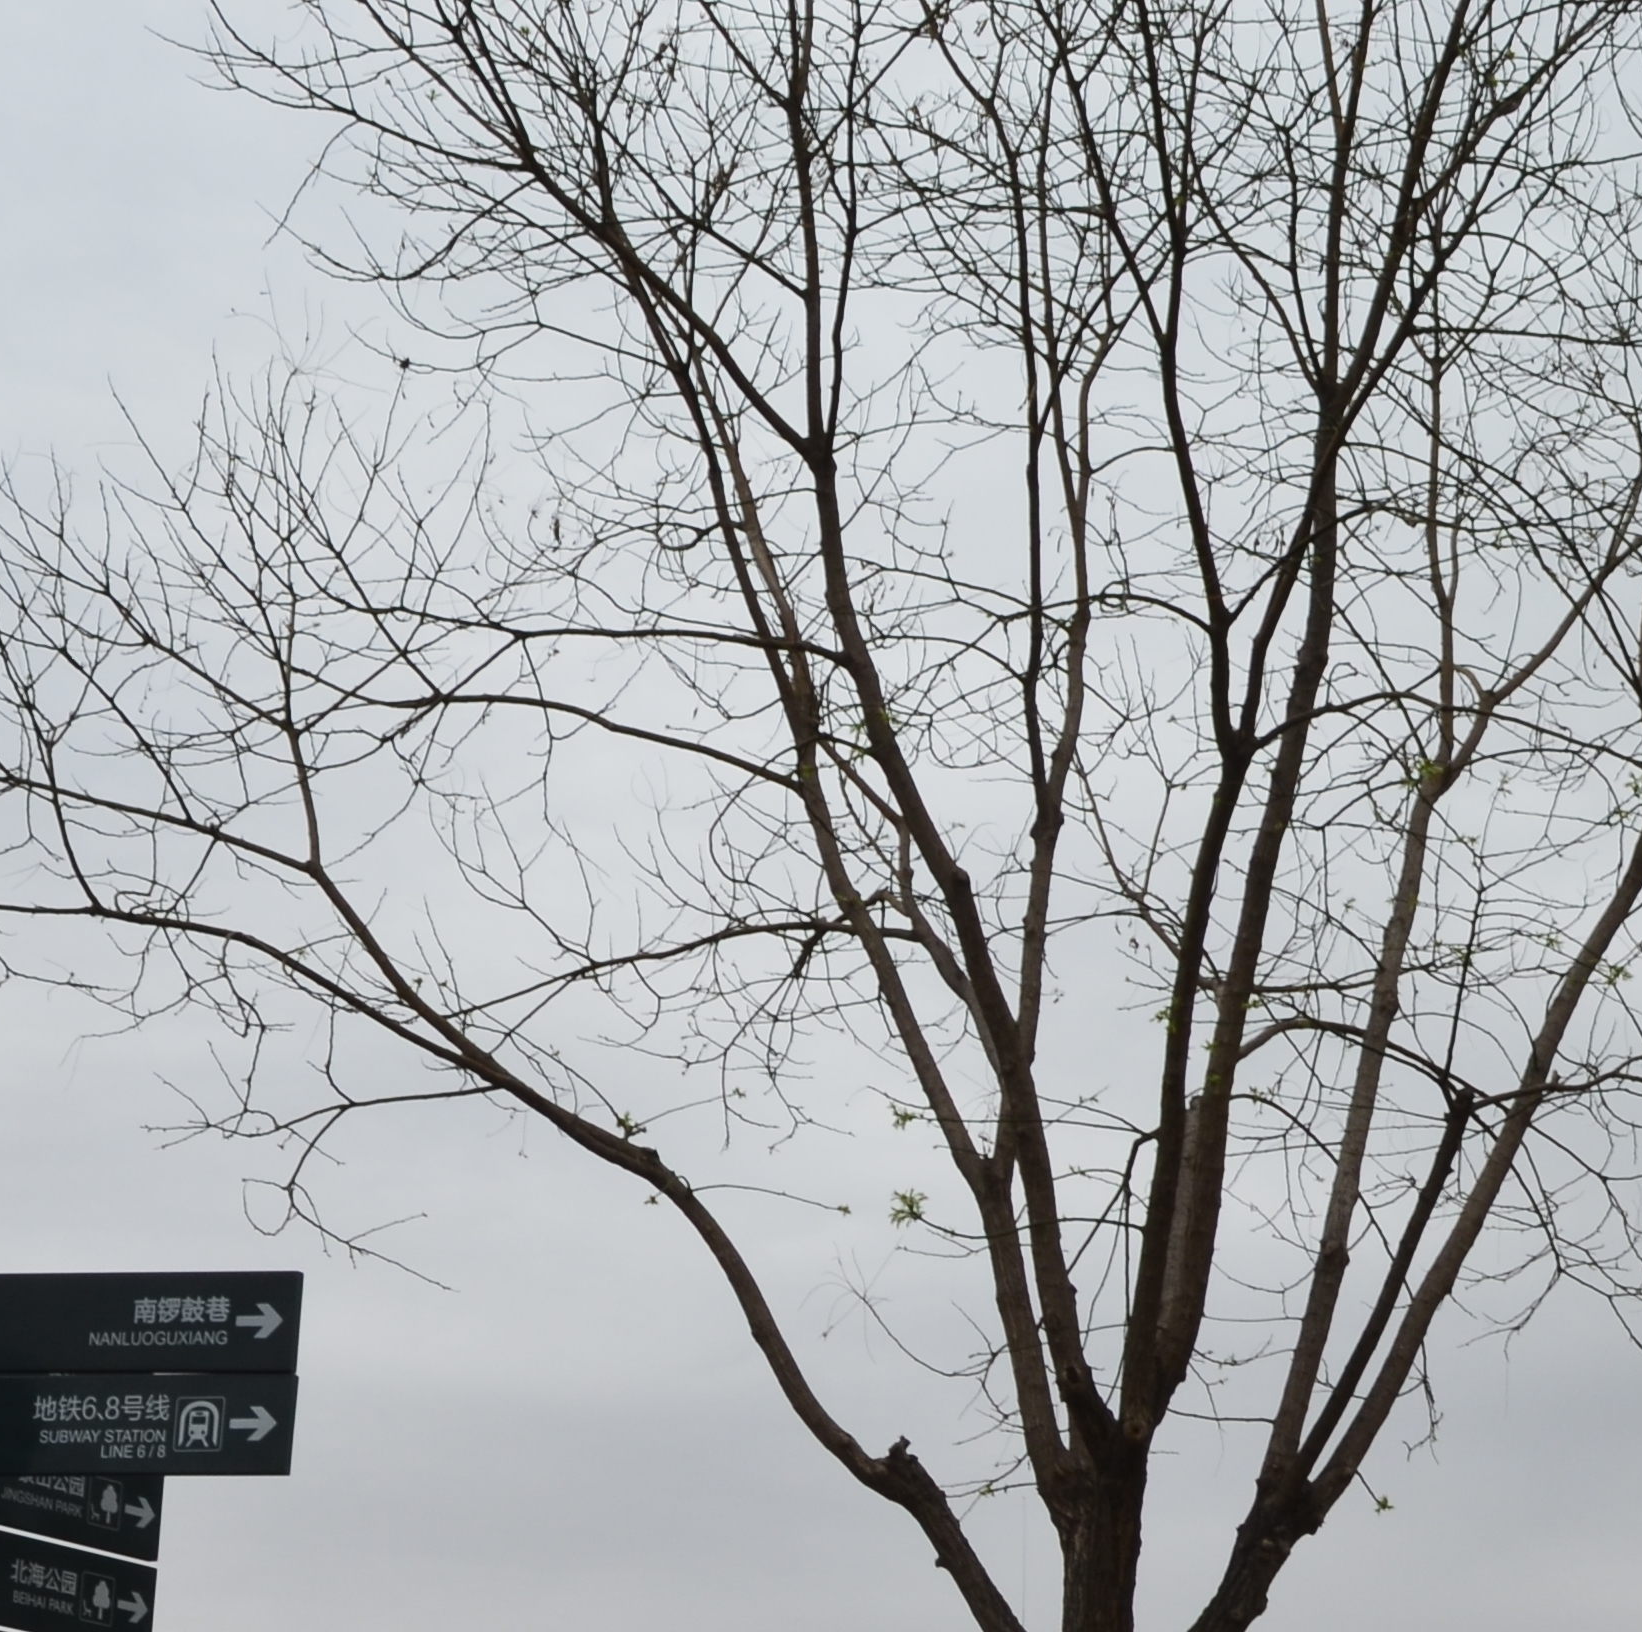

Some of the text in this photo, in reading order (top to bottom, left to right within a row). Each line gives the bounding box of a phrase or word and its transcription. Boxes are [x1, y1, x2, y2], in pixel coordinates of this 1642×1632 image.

[133, 1296, 230, 1324] 南锣鼓巷
[88, 1330, 229, 1346] NANLUOGUXIANG
[39, 1429, 167, 1444] SUBWAY STATION
[100, 1445, 134, 1459] LINE
[0, 1486, 83, 1518] JINGSHAN PARK
[10, 1559, 77, 1596] 北海公园
[12, 1590, 75, 1616] BEIHAI PARK
